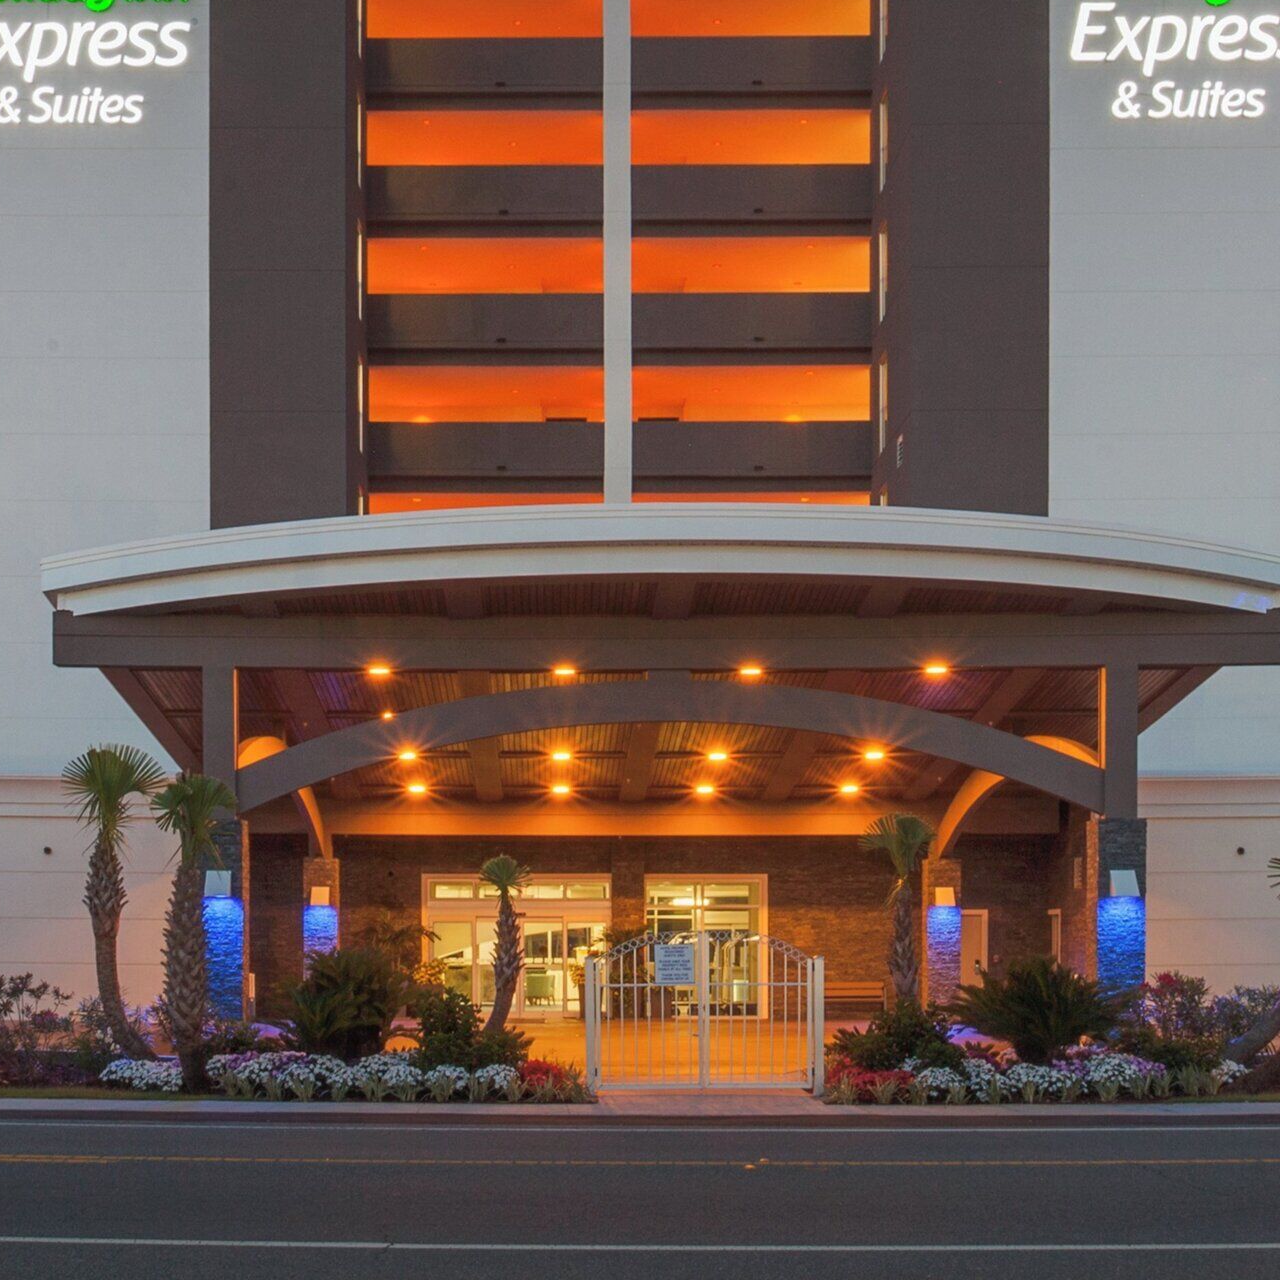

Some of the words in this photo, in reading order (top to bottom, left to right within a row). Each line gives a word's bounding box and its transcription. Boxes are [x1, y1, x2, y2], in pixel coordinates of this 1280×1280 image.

[27, 85, 144, 124] Suites
[1111, 80, 1141, 119] &
[1147, 80, 1265, 119] Suites
